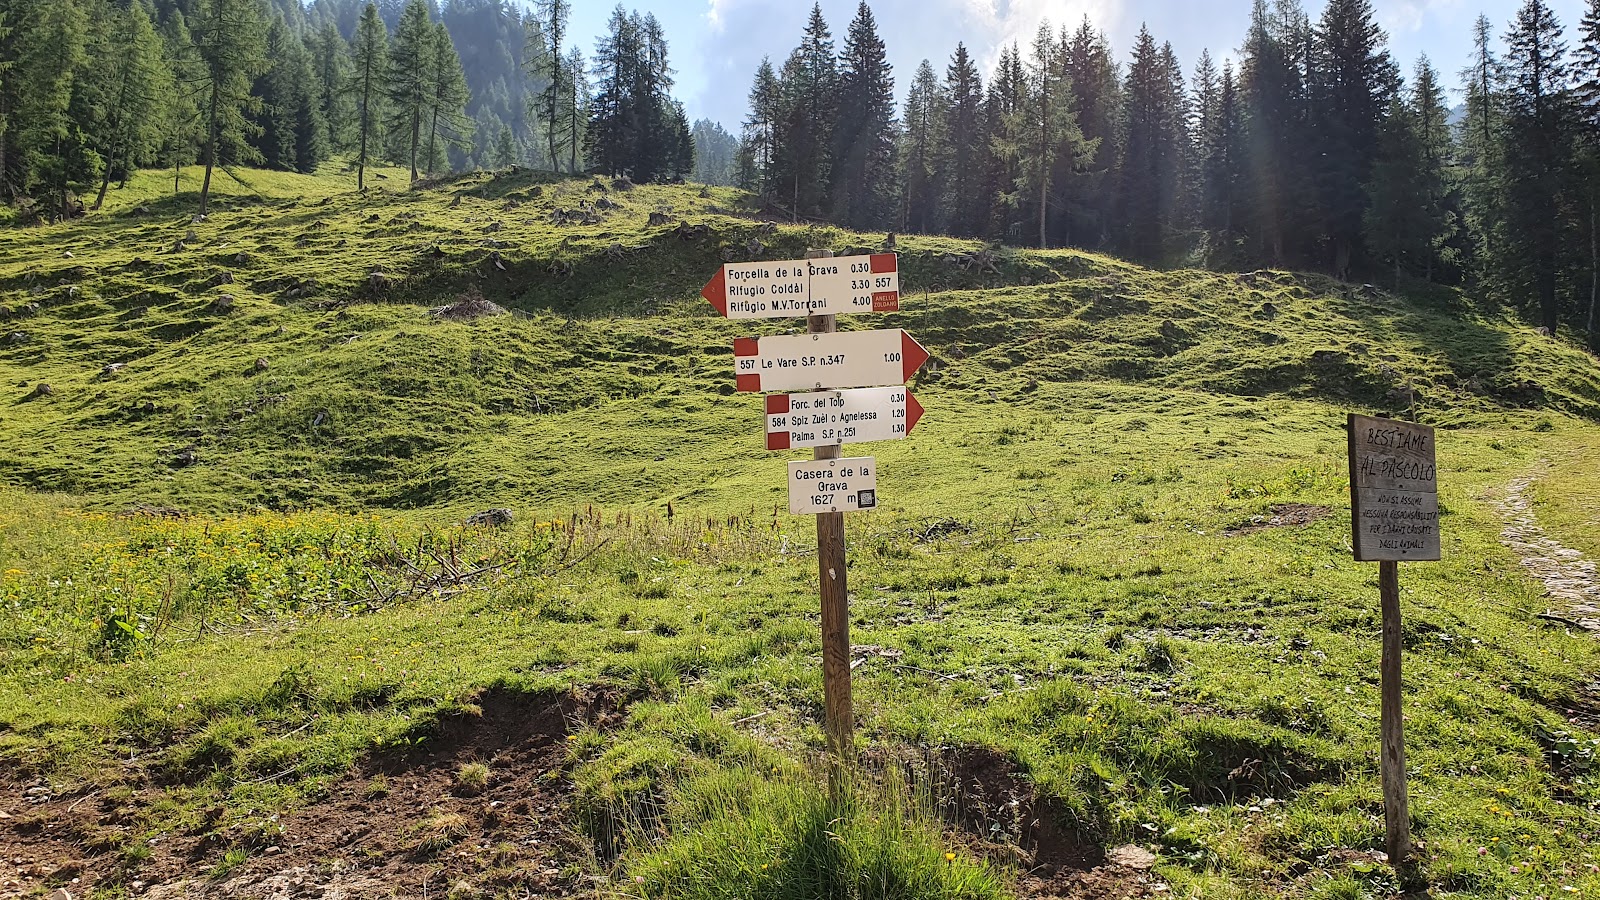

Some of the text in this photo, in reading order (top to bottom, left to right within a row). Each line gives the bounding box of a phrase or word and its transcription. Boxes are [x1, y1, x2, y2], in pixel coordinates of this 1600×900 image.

[729, 265, 838, 280] Forcella de la Grava
[850, 262, 870, 274] 0.30
[851, 279, 870, 290] 3.30
[875, 277, 891, 288] 557
[729, 285, 765, 298] Rifugio
[852, 296, 871, 306] 4.00
[730, 301, 766, 313] Rifugio
[761, 354, 845, 369] Le Vare S.P. n.347
[884, 352, 901, 363] 1.00
[740, 360, 755, 370] 557
[791, 396, 845, 410] Forc. del Tolp
[890, 393, 905, 403] 0.30
[892, 408, 905, 418] 1.20
[772, 416, 786, 427] 584
[791, 415, 809, 427] Spiz
[831, 414, 837, 423] o
[839, 411, 877, 424] Agnelessa
[892, 423, 905, 433] 1.30
[791, 427, 856, 442] Palma S.P. n.251
[1367, 427, 1428, 451] BESTIAME
[795, 466, 870, 480] Casera de la
[1360, 455, 1434, 481] AL PASCOLO
[818, 481, 848, 492] Grava
[810, 494, 857, 505] 1627 m
[1378, 495, 1423, 506] NON SI ASSUME
[1363, 508, 1389, 519] NESSUNA
[1369, 524, 1381, 534] PER
[1406, 525, 1433, 535] CAUSATI
[1379, 539, 1425, 549] DAGLI ANIMALI
